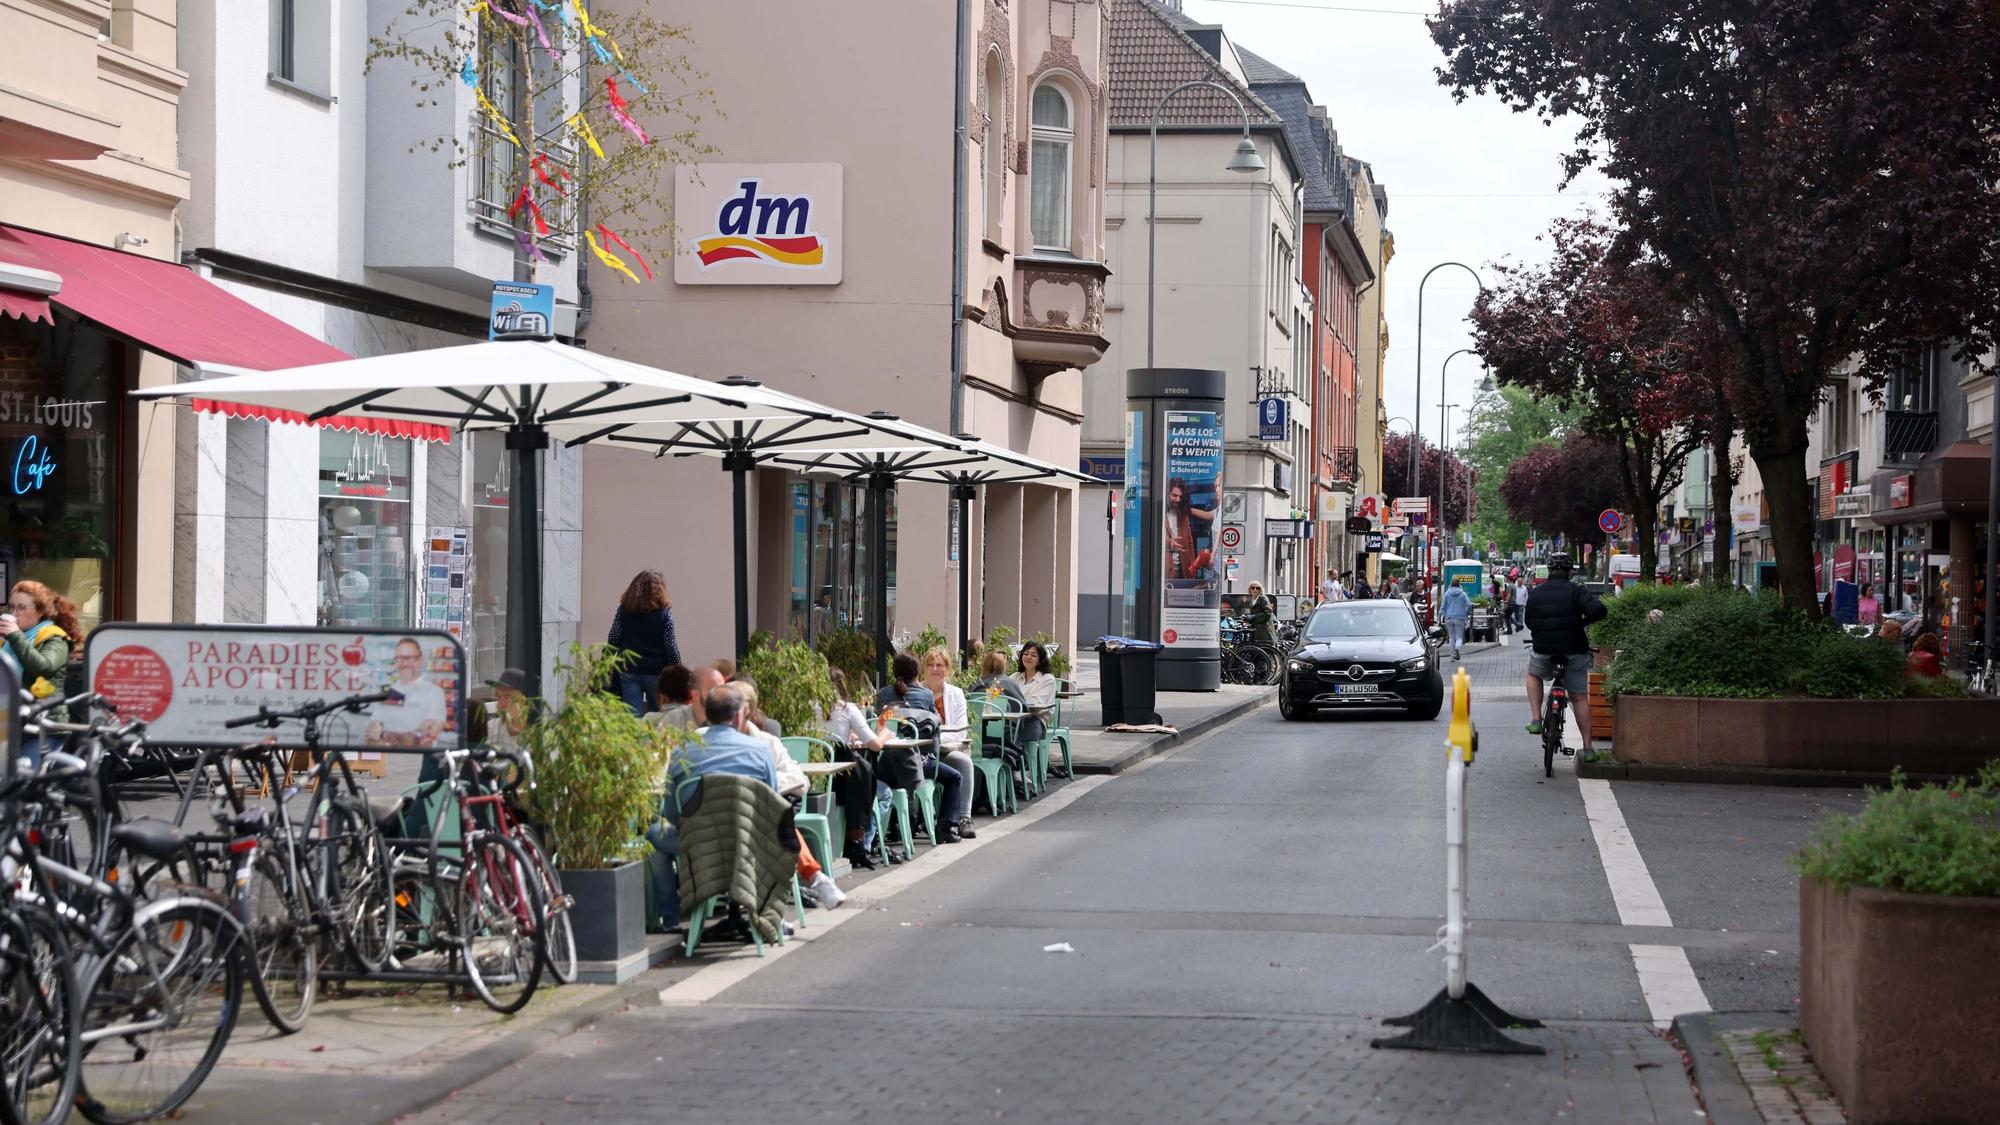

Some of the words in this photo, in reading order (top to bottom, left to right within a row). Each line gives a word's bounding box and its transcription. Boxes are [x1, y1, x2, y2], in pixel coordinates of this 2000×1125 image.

[718, 181, 810, 236] dm
[34, 396, 93, 429] LOUIS
[1171, 427, 1197, 436] LASS
[1259, 424, 1284, 435] HOTEL
[1171, 437, 1200, 446] AUCH
[1171, 447, 1183, 456] ES
[1185, 448, 1220, 457] WEHTUT
[15, 435, 56, 494] Café
[1224, 532, 1237, 542] 30
[188, 641, 338, 665] PARADIES
[182, 666, 364, 690] APOTHEKE
[1364, 685, 1378, 693] 506
